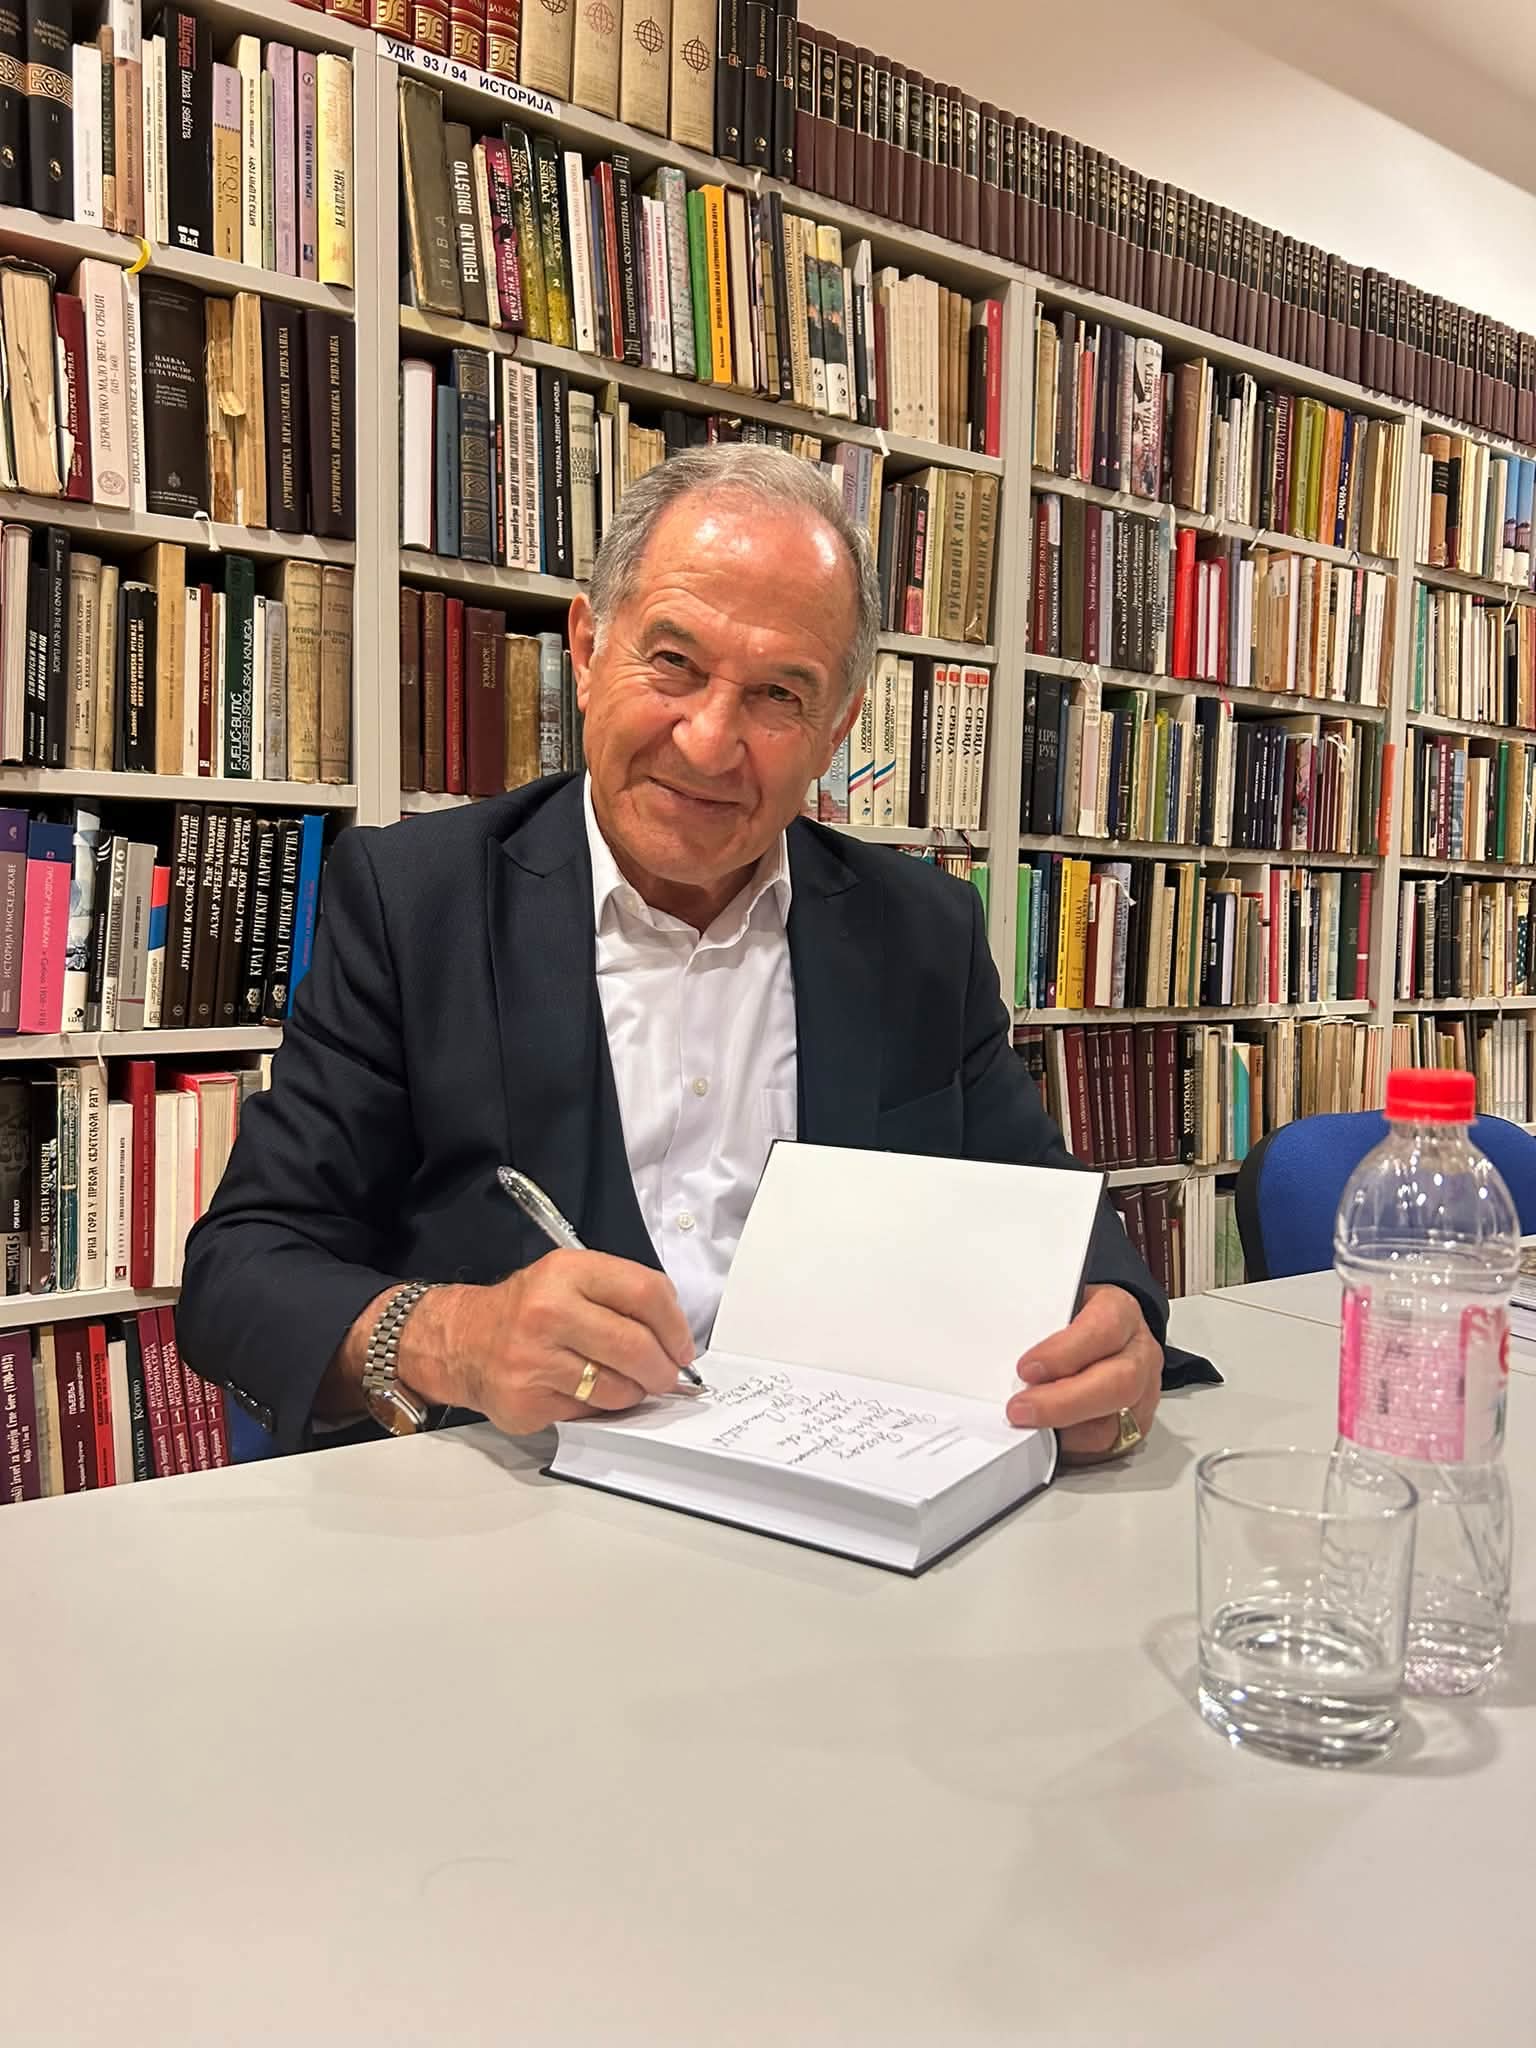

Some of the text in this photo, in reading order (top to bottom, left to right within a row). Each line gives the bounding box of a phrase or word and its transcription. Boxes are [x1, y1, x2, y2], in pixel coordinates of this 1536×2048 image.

[386, 41, 554, 114] УДК 93 94 ИСТОРИЈА
[182, 106, 194, 139] sekira
[496, 151, 509, 225] SILENT BELLS
[540, 157, 551, 204] POVIJEST
[178, 233, 199, 248] Rad
[454, 160, 480, 283] FEUDALNO DRUŠTVO
[504, 237, 514, 272] ЗВОНА
[620, 178, 637, 333] ПОДГОРИЧКА СКУПШТИНА 1918
[99, 364, 108, 392] МАЛО
[126, 301, 141, 485] DUKLJANSKI KNEZ SVETI VLADIMIR
[954, 491, 967, 532] АПИС
[244, 618, 253, 661] KNJIGA
[936, 704, 944, 755] СРБИЈА
[948, 705, 957, 755] СРБИЈА
[963, 707, 973, 756] СРБИЈА
[974, 707, 985, 757] СРБИЈА
[242, 754, 251, 772] SN
[114, 849, 126, 897] КЛИО
[177, 814, 190, 887] Раде Михаљчић
[203, 814, 217, 887] Раде Михаљчић
[181, 815, 200, 971] ЈУНАЦИ КОСОВСКЕ ЛЕГЕНДЕ
[209, 816, 228, 939] ЛАЗАР ХРЕБЕЉАНОВИЋ
[229, 867, 239, 888] Раде
[235, 818, 252, 943] КРАЈ СРПСКОГ ЦАРСТВА
[276, 830, 299, 973] КРАЈ СРПСКОГ ЦАРСТВА
[4, 863, 17, 978] ИСТОРИЈА РИМСКЕ ДРЖАВЕ
[250, 832, 274, 977] КРАЈ СРПСКОГ ЦАРСТВА
[90, 1086, 99, 1108] РАТУ
[89, 1112, 99, 1162] СВЈЕТСКОМ
[89, 1167, 99, 1198] ПРВОМ
[42, 1197, 50, 1223] OTETI
[88, 1211, 97, 1234] ГОРА
[88, 1236, 97, 1261] ЦРНА
[68, 1381, 77, 1415] ПЉЕВЉА
[150, 1342, 164, 1409] ИСТОРИЈА СРБА
[169, 1340, 182, 1407] ИСТОРИЈА СРБА
[5, 1394, 16, 1411] Gore
[7, 1411, 18, 1428] Crne
